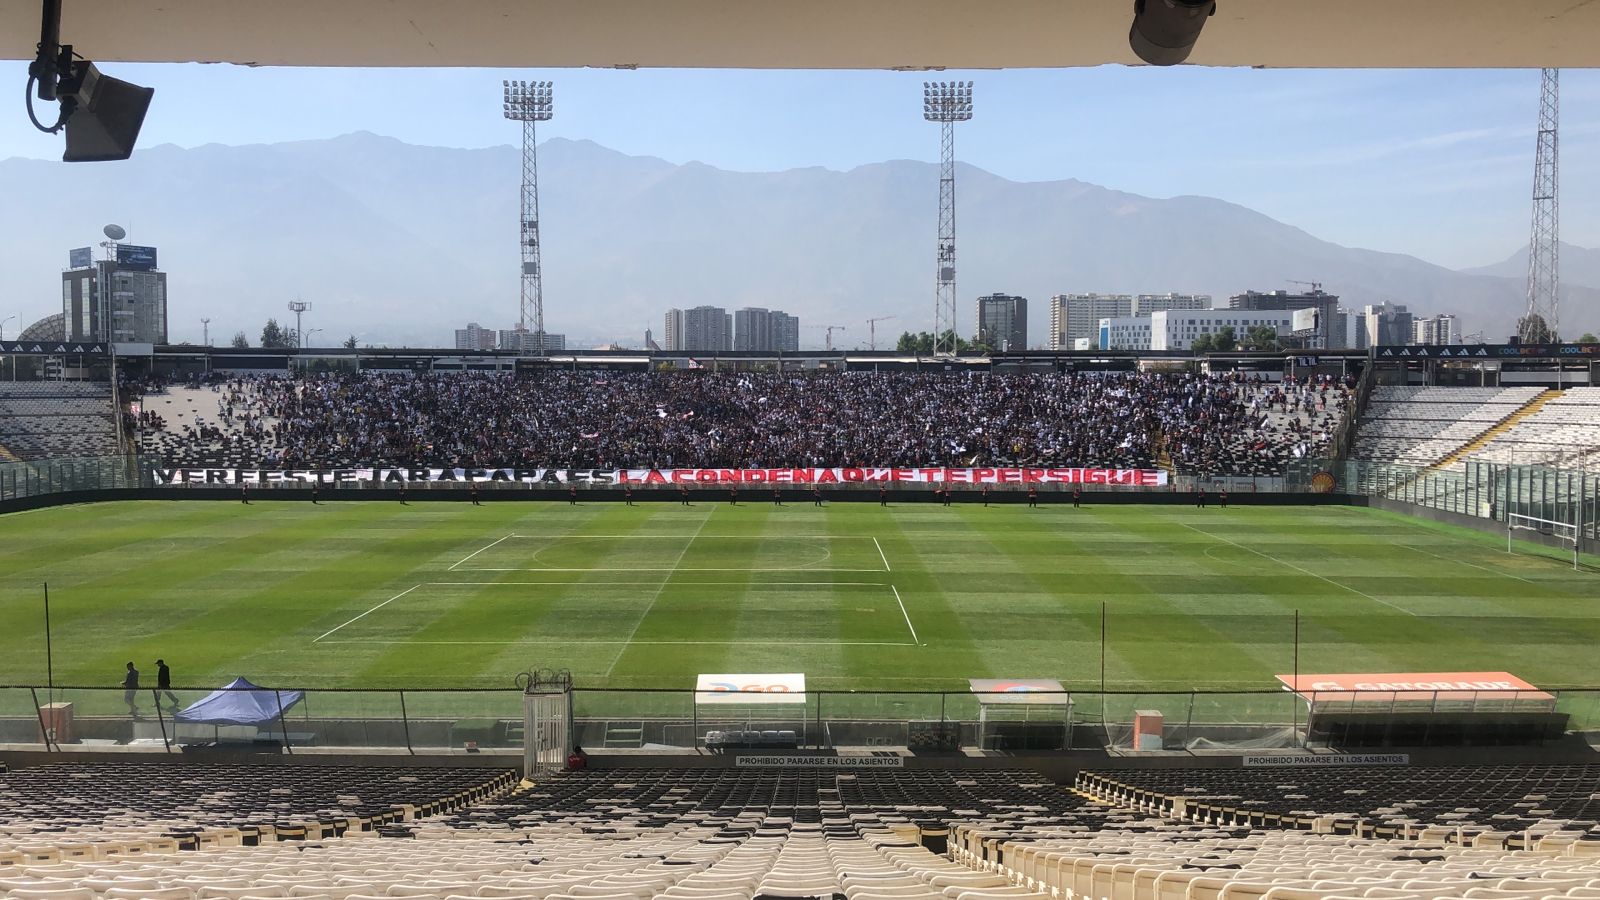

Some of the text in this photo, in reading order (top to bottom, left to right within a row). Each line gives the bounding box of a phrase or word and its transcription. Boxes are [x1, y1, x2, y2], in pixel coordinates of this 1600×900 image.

[154, 469, 229, 483] VER
[739, 757, 900, 765] PROHIBIDO PARARSE EN LOS ASIENTOS
